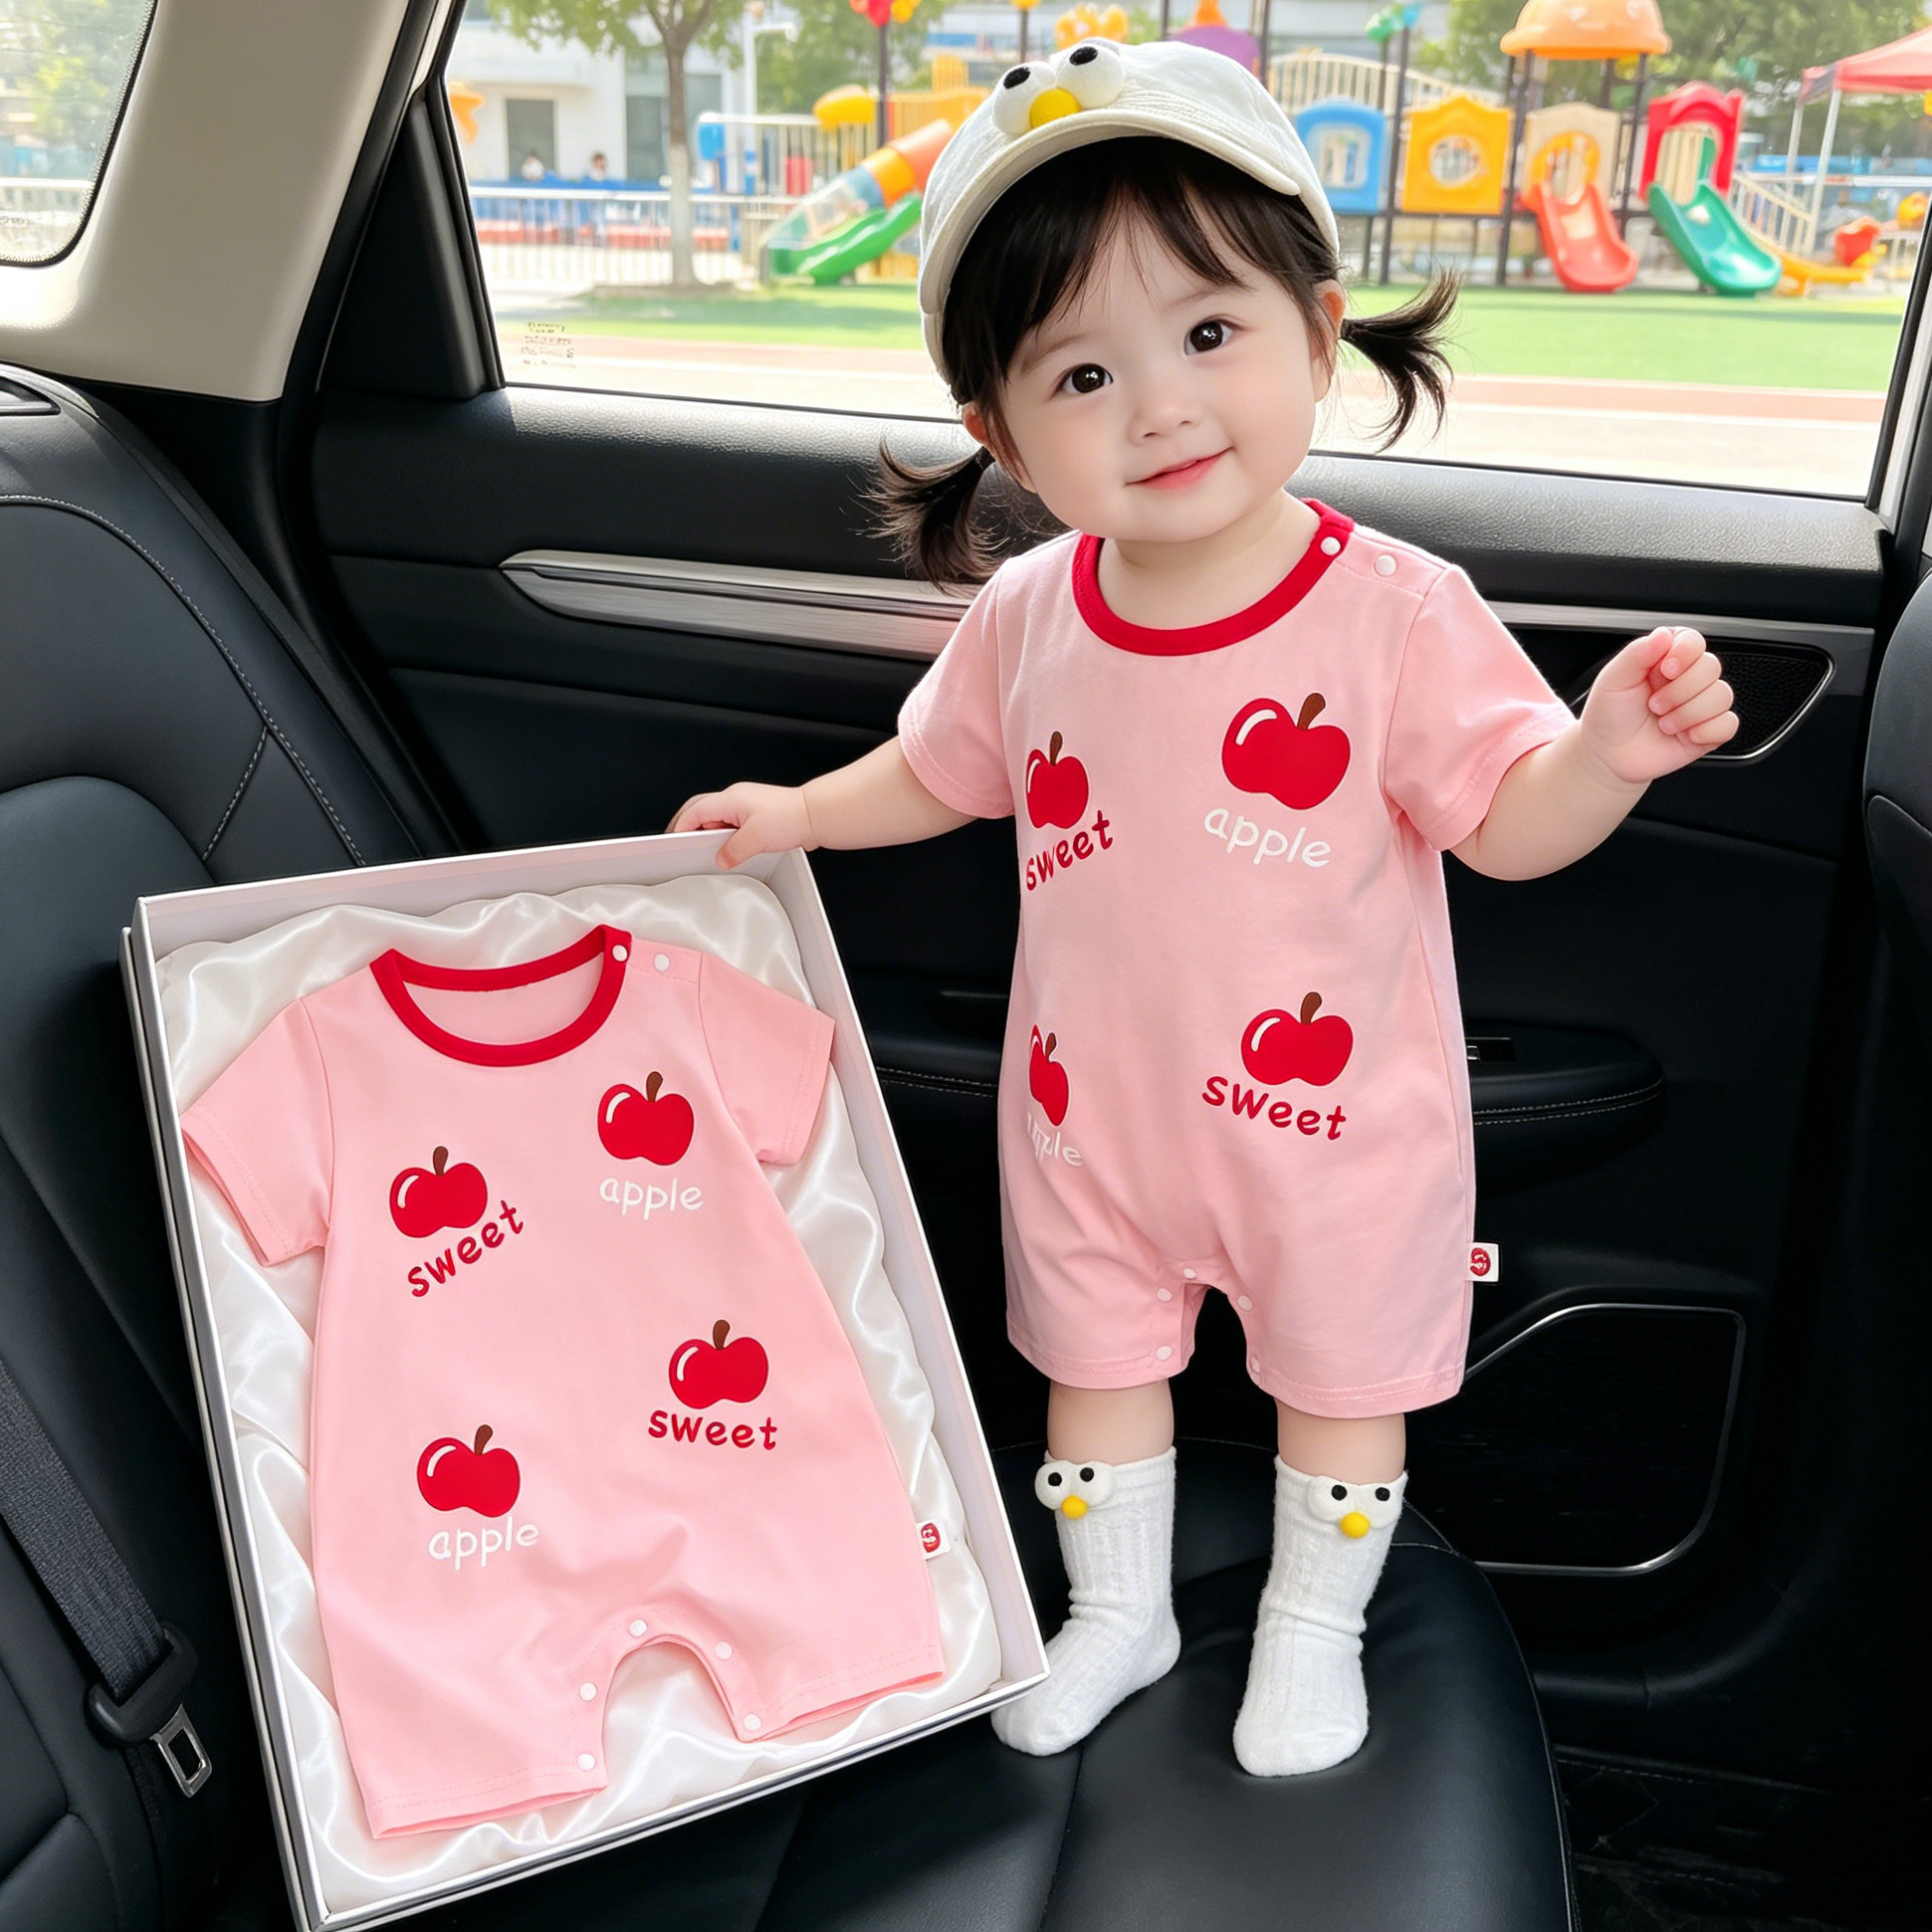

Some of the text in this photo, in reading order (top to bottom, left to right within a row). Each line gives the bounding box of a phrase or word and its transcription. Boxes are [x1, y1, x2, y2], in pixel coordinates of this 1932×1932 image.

[1025, 809, 1114, 891] sweet
[1203, 807, 1332, 868] apple
[1201, 1076, 1347, 1140] sweet
[599, 1178, 704, 1220] apple
[407, 1199, 524, 1297] sweet
[648, 1409, 777, 1450] sweet
[428, 1516, 539, 1571] apple
